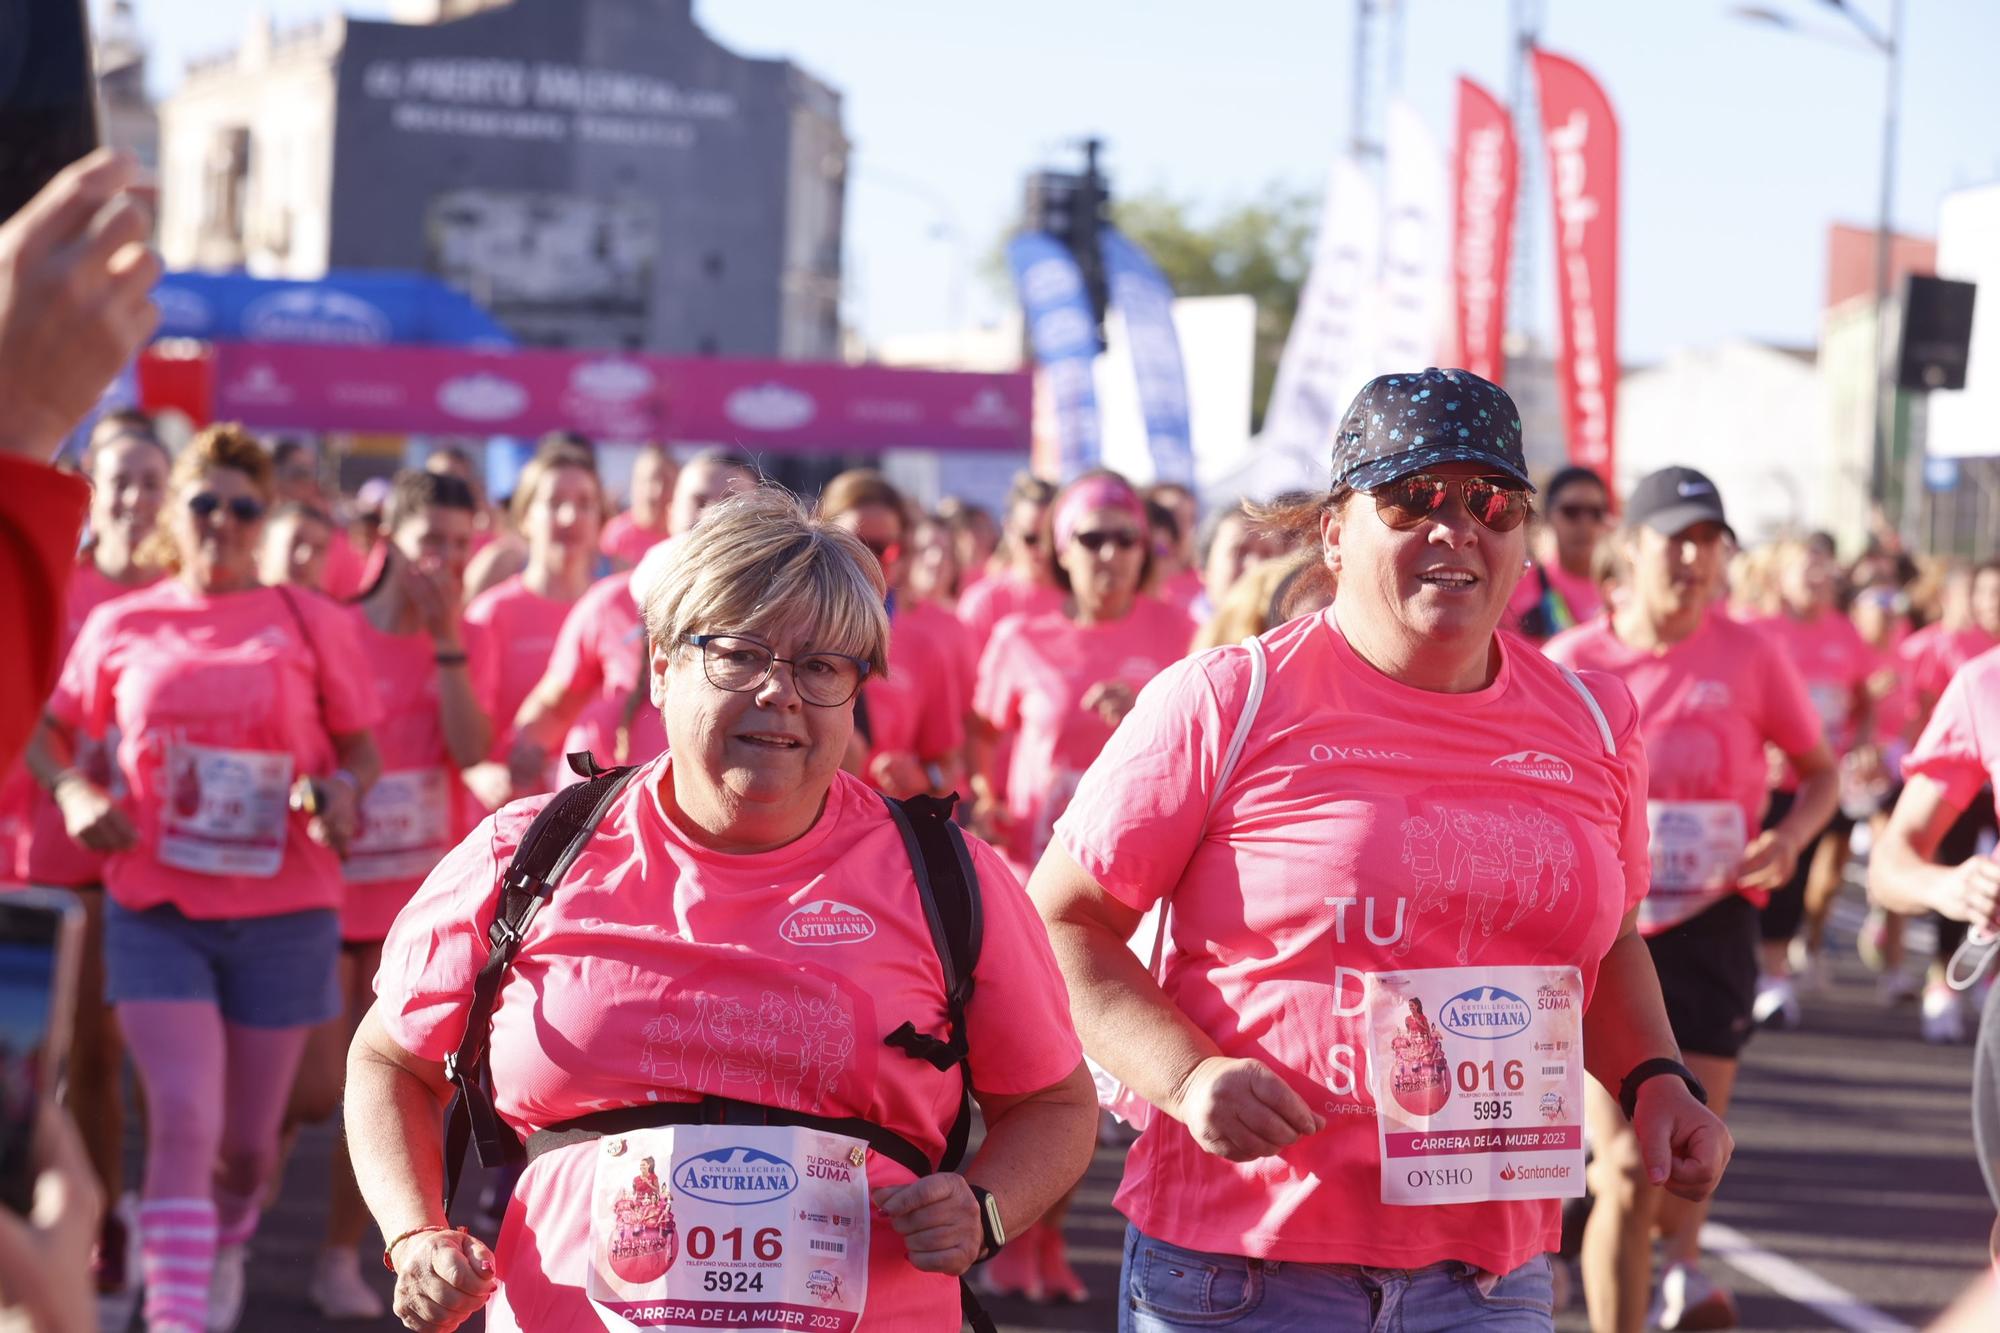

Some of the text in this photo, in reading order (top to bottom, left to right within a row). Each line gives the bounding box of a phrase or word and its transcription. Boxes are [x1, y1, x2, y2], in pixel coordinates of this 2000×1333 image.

[788, 920, 870, 938] ASTURIANA
[1325, 896, 1406, 946] TU
[1537, 998, 1571, 1010] SUMA
[1448, 1007, 1526, 1026] ASTURIANA
[1456, 1060, 1524, 1092] 016
[1474, 1100, 1512, 1120] 5995
[1411, 1132, 1566, 1150] CARRERA DE LA MUJER 2023
[702, 1166, 786, 1174] CENTRAL LECHERA
[806, 1155, 850, 1170] TU DORSAL
[682, 1168, 790, 1190] ASTURIANA
[806, 1165, 850, 1182] SUMA
[1408, 1164, 1570, 1187] OYSHO Santander
[686, 1226, 782, 1261] 016
[703, 1272, 763, 1292] 5924
[622, 1306, 840, 1330] CARRERA DE LA MUJER 2023
